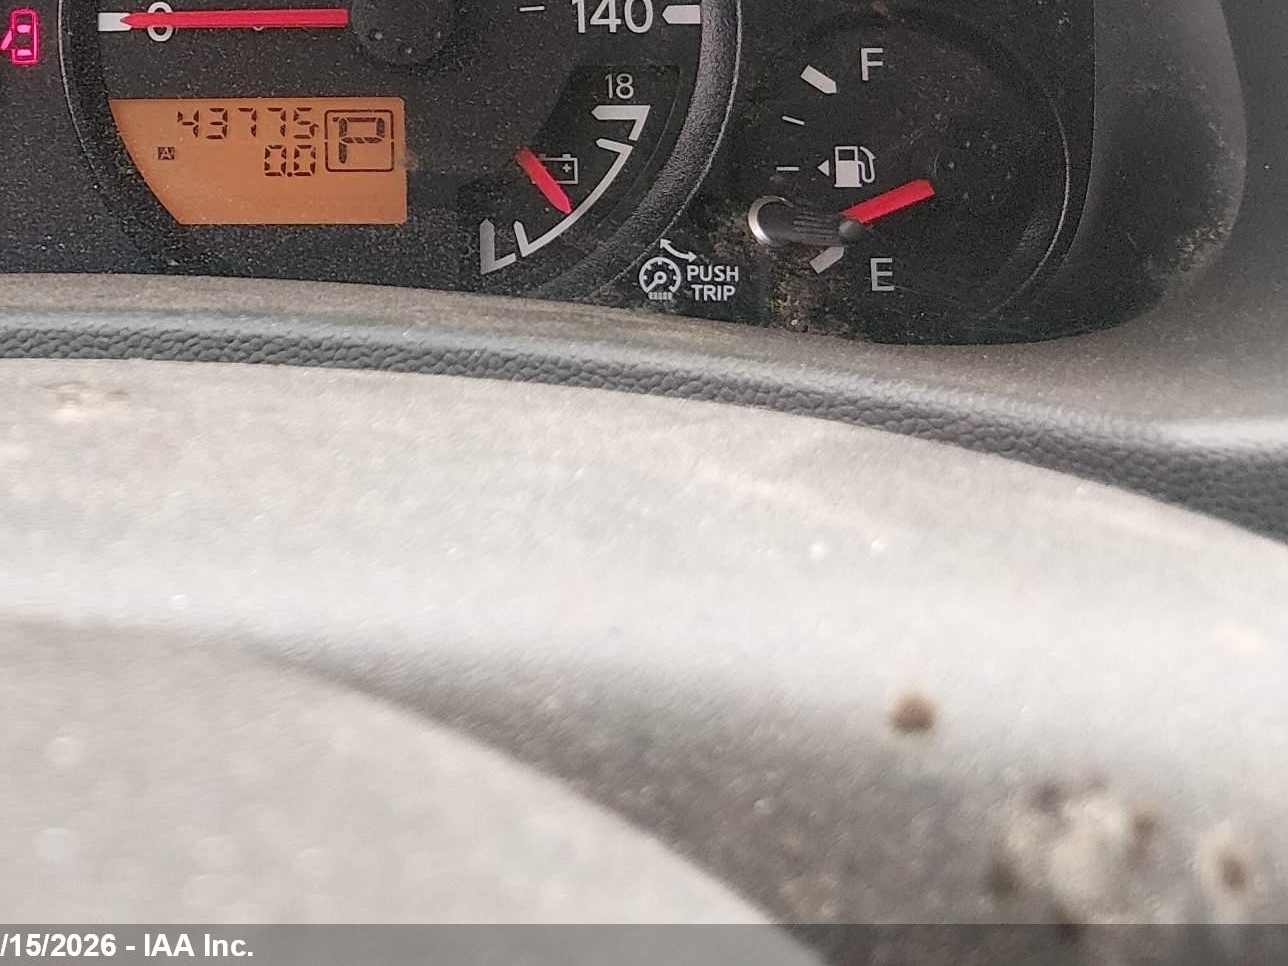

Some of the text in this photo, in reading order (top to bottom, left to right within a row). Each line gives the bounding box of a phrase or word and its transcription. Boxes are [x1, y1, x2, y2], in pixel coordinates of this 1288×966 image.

[861, 47, 883, 81] F
[608, 74, 634, 99] 18
[177, 107, 317, 139] 43775
[332, 117, 385, 164] P
[264, 144, 317, 177] 0.0
[686, 265, 740, 282] PUSH
[870, 257, 895, 292] E
[691, 284, 736, 301] TRIP
